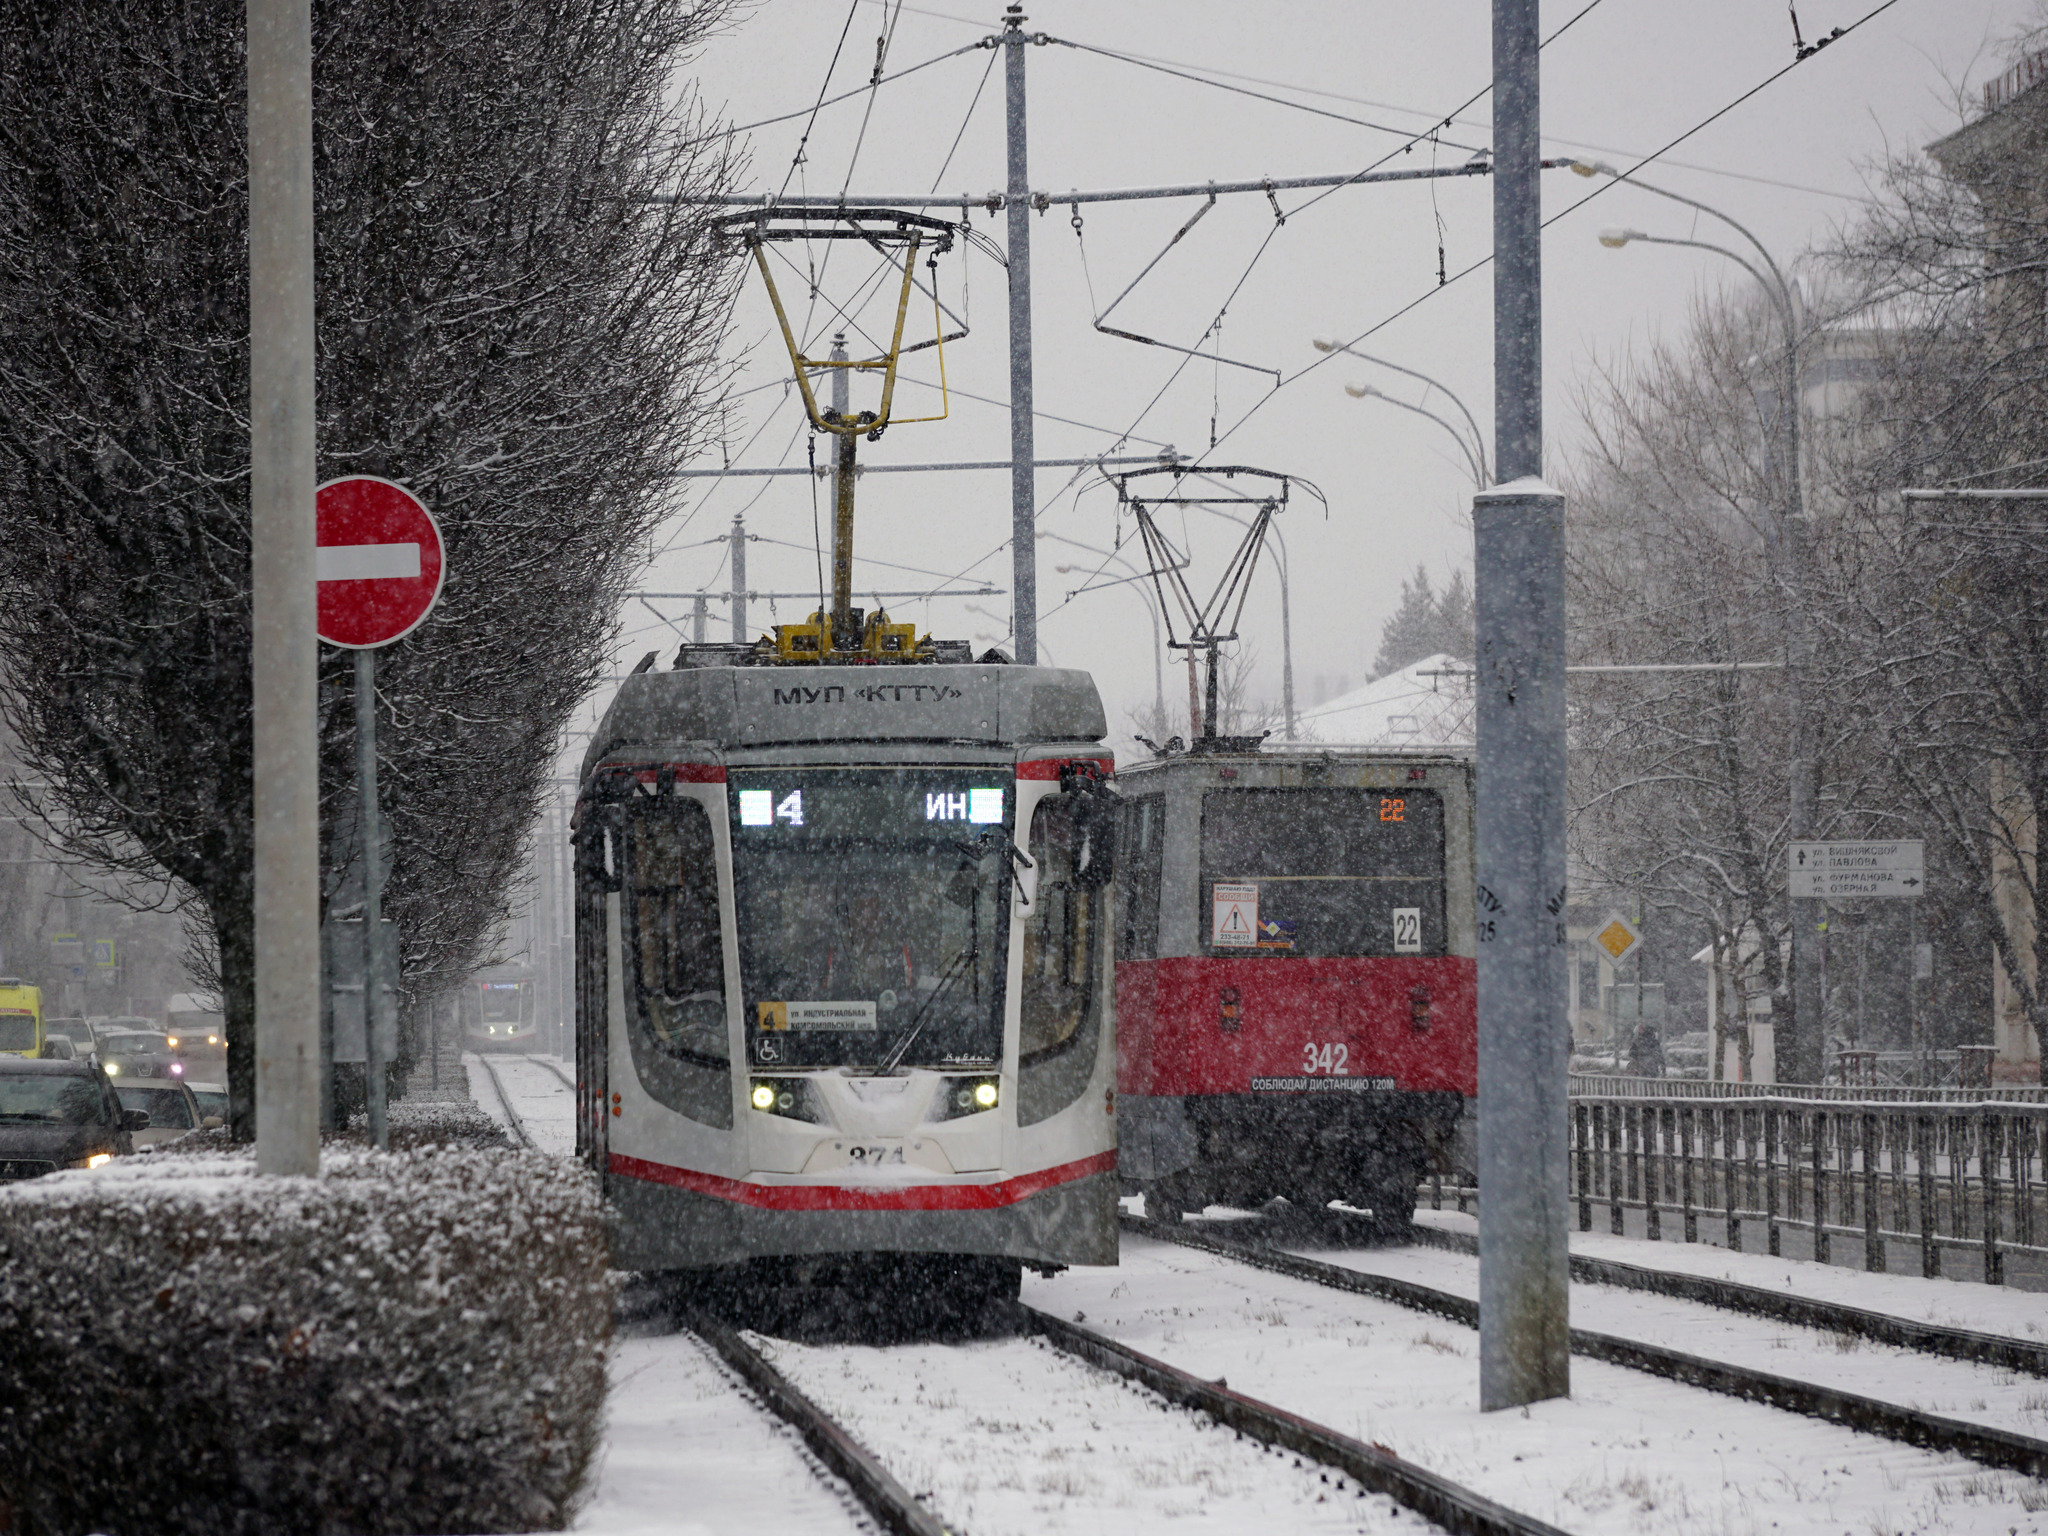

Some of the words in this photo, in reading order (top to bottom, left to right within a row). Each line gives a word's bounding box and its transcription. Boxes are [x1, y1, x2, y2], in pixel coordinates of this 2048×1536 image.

[774, 686, 845, 705] МУП
[853, 685, 962, 702] «КТТУ»
[776, 789, 804, 825] 4
[926, 792, 967, 820] ИН
[1380, 799, 1404, 821] 22
[1829, 858, 1878, 867] ПАВЛОВА
[1829, 872, 1894, 882] ФУРМАНОВА
[1830, 884, 1877, 894] ОЗЕРНАЯ
[1396, 914, 1418, 946] 22
[763, 1011, 776, 1030] 4
[803, 1009, 867, 1017] ИНДУСТРИАЛЬНАЯ
[790, 1021, 855, 1030] КОМСОМОЛЬСКИЙ
[1303, 1042, 1348, 1075] 342
[1252, 1078, 1308, 1090] СОБЛЮДАЙ
[1309, 1078, 1369, 1090] ДИСТАНЦИЮ
[1371, 1078, 1395, 1090] 120М
